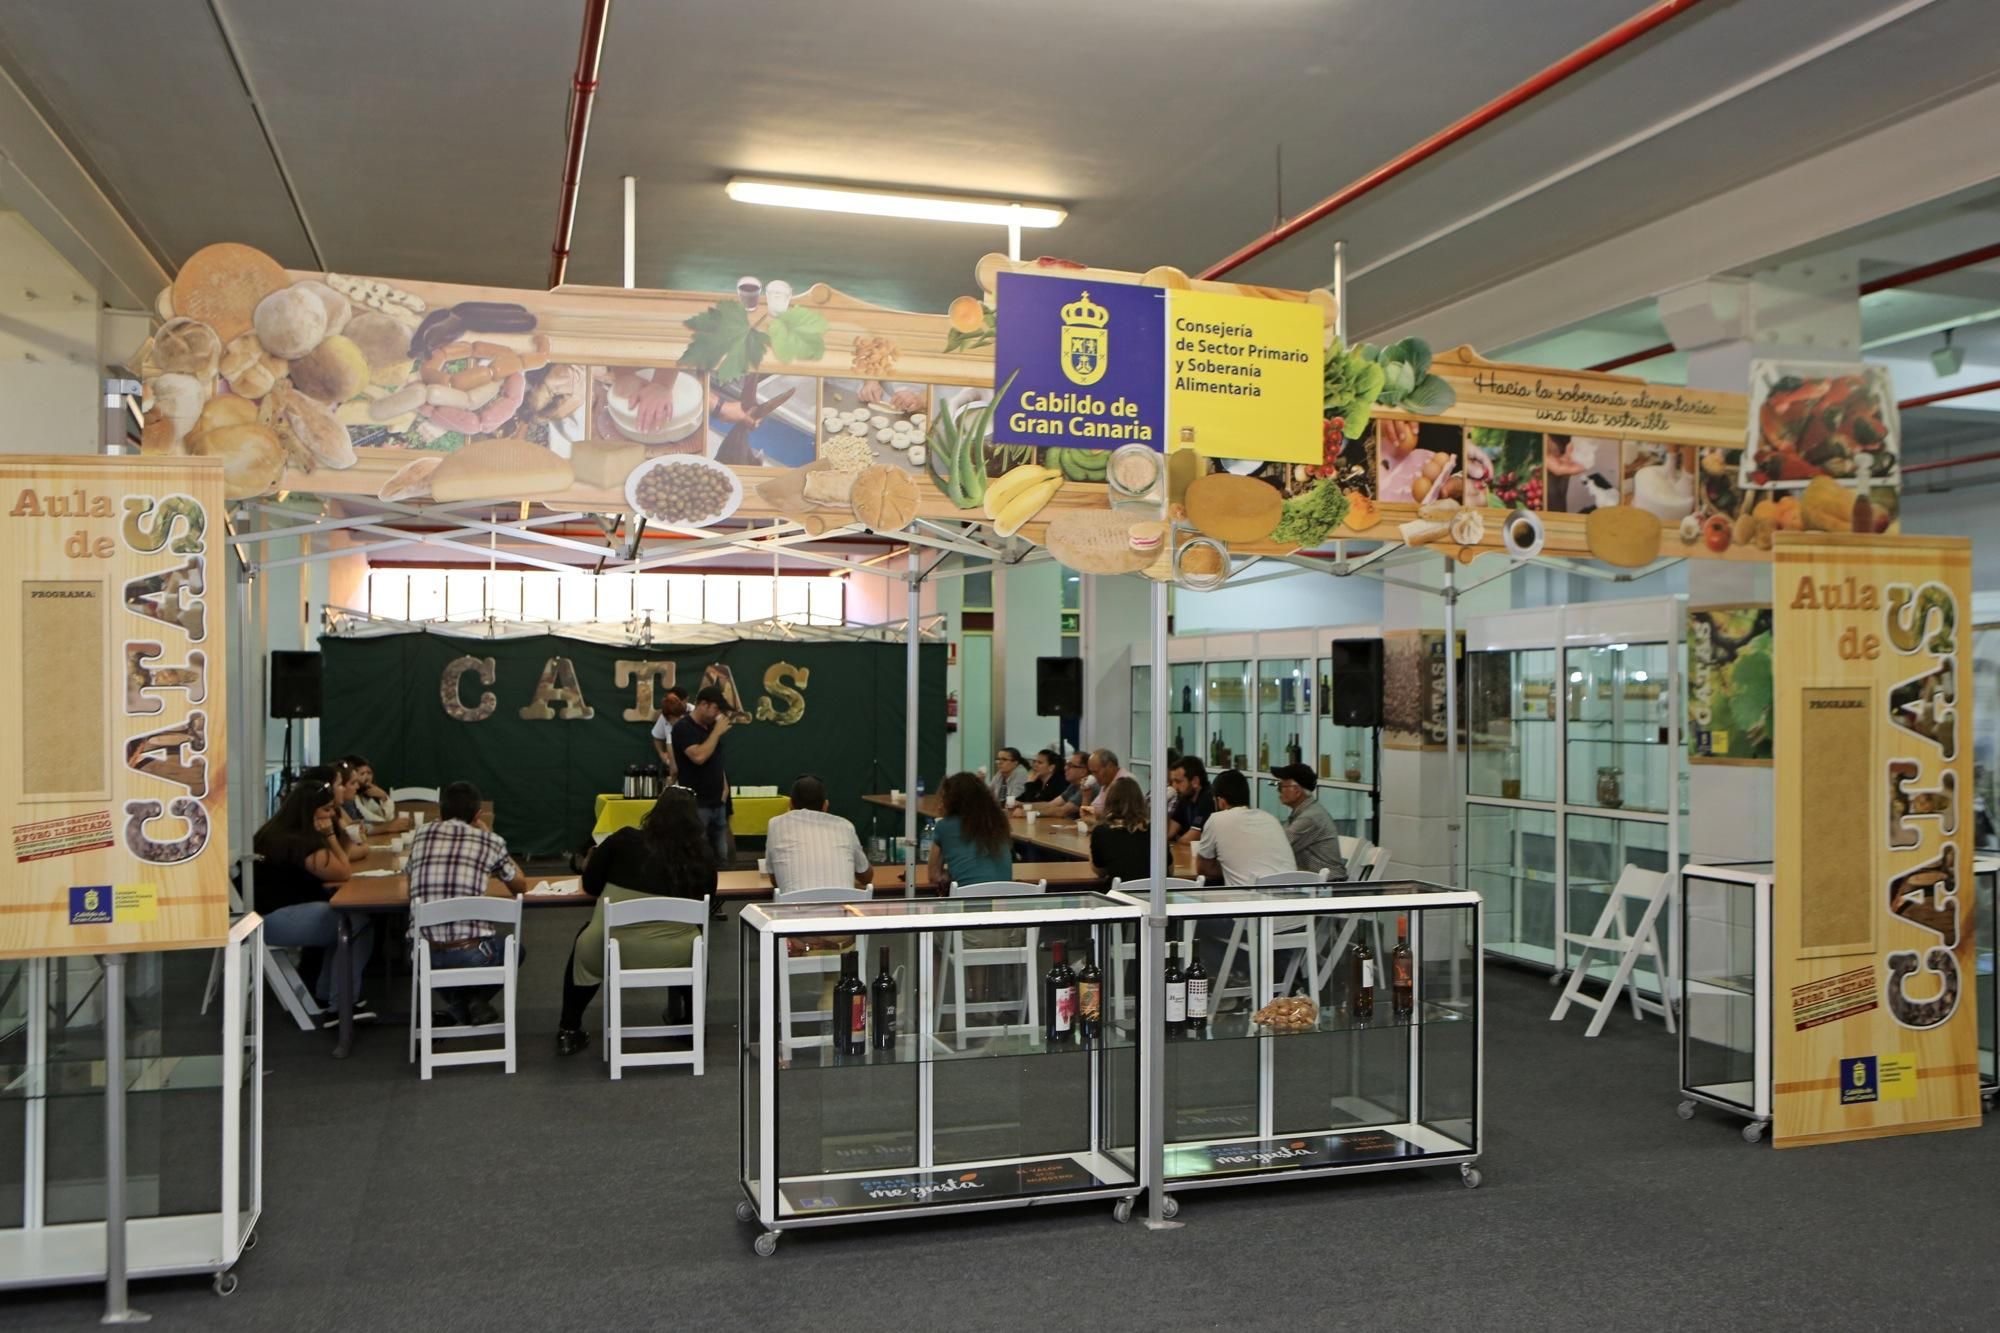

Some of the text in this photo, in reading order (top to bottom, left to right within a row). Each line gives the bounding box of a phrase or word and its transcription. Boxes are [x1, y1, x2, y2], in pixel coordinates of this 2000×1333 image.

[1176, 317, 1253, 338] Consejería
[1176, 337, 1309, 363] de Sector Primario
[1176, 358, 1262, 378] y Soberanía
[1175, 377, 1261, 397] Alimentaria
[1473, 371, 1530, 397] Hacia
[1533, 379, 1553, 399] la
[1020, 390, 1138, 418] Cabildo de
[1535, 407, 1567, 422] una
[1009, 412, 1153, 441] Gran Canaria
[9, 487, 115, 518] Aula
[64, 531, 115, 559] de
[1790, 575, 1880, 611] Aula
[1837, 626, 1880, 660] de
[122, 493, 211, 866] CATAS
[440, 655, 811, 727] CATAS
[1886, 580, 1962, 1030] CATAS
[14, 830, 51, 844] AFORO
[54, 820, 112, 836] LIMITADO
[1216, 1146, 1318, 1164] me gusta
[869, 1178, 984, 1199] me gusta
